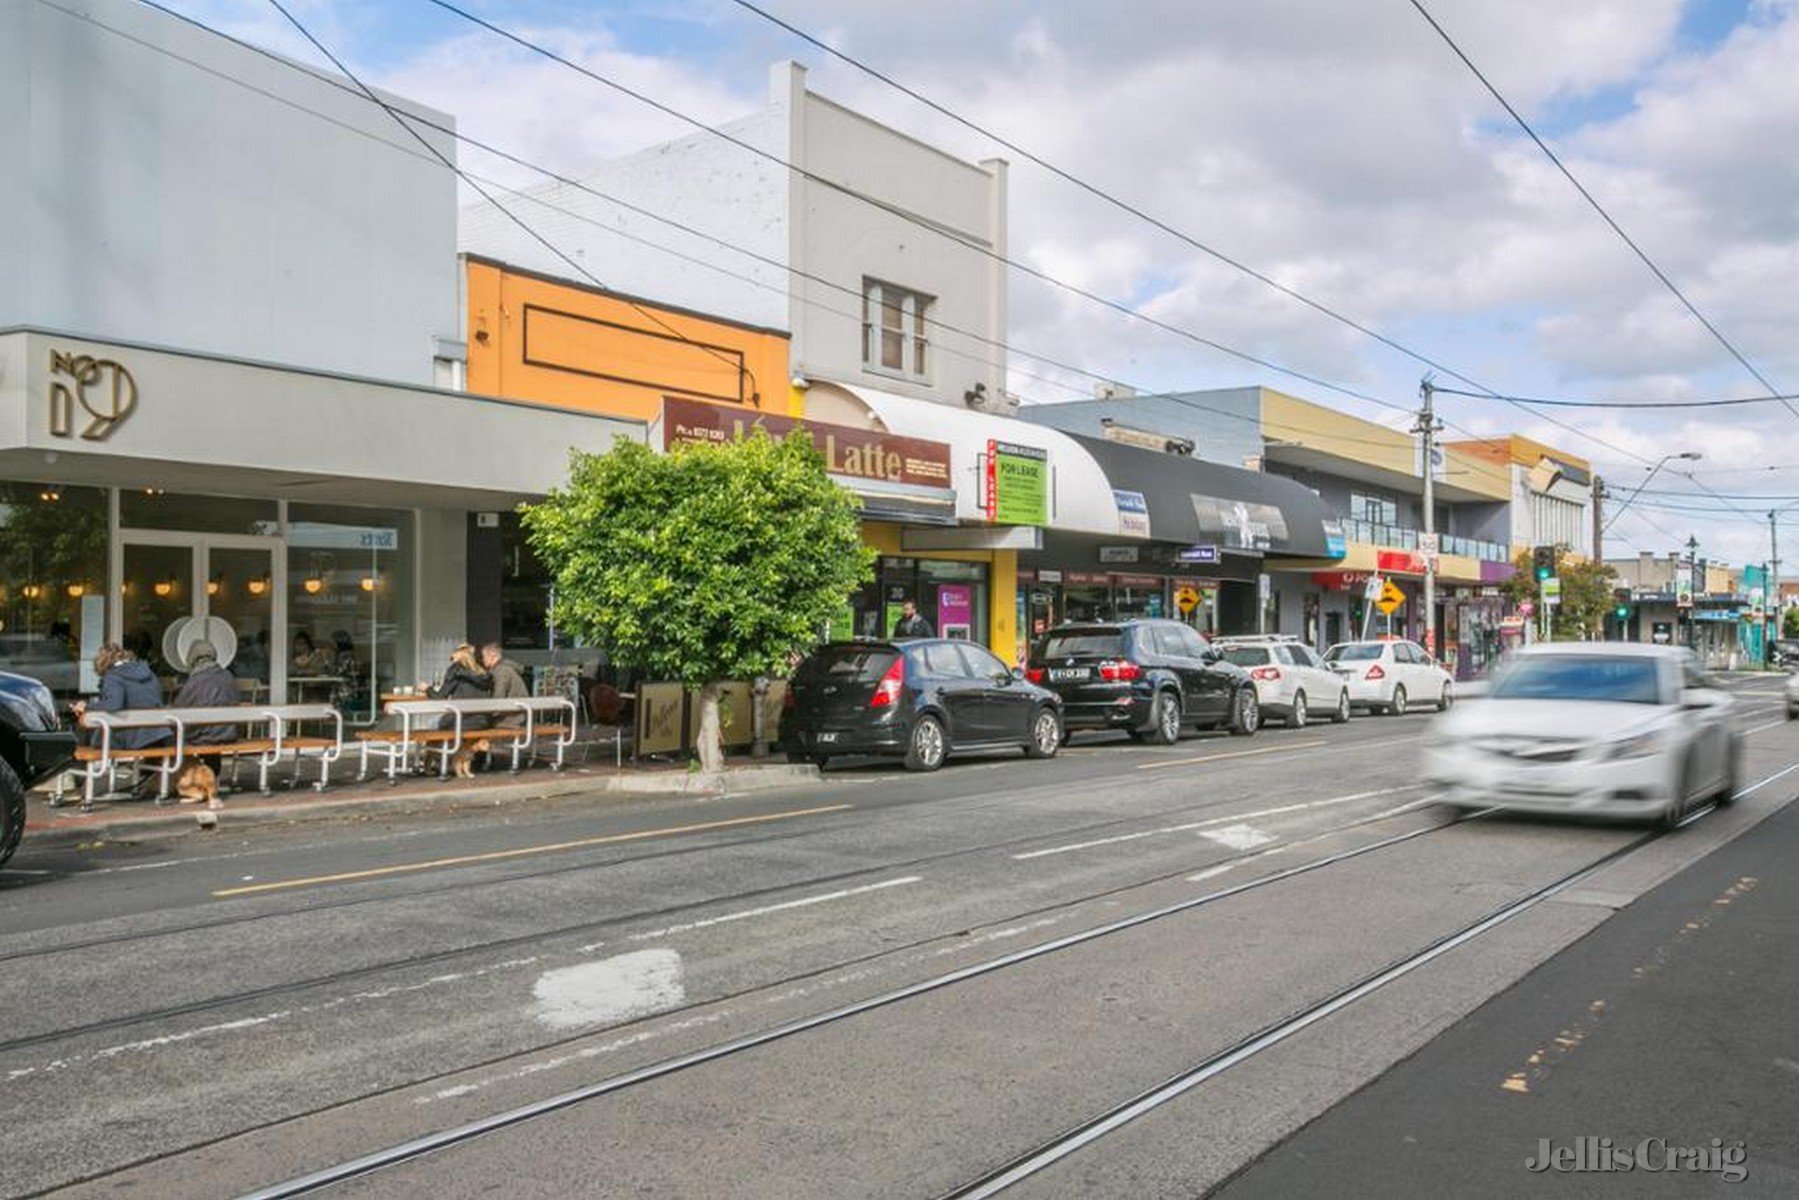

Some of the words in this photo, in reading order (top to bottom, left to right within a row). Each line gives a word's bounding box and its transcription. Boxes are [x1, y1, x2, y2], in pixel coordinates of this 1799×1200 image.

[826, 435, 901, 480] Latte
[1001, 463, 1015, 474] FOR
[1017, 465, 1039, 478] LEASE
